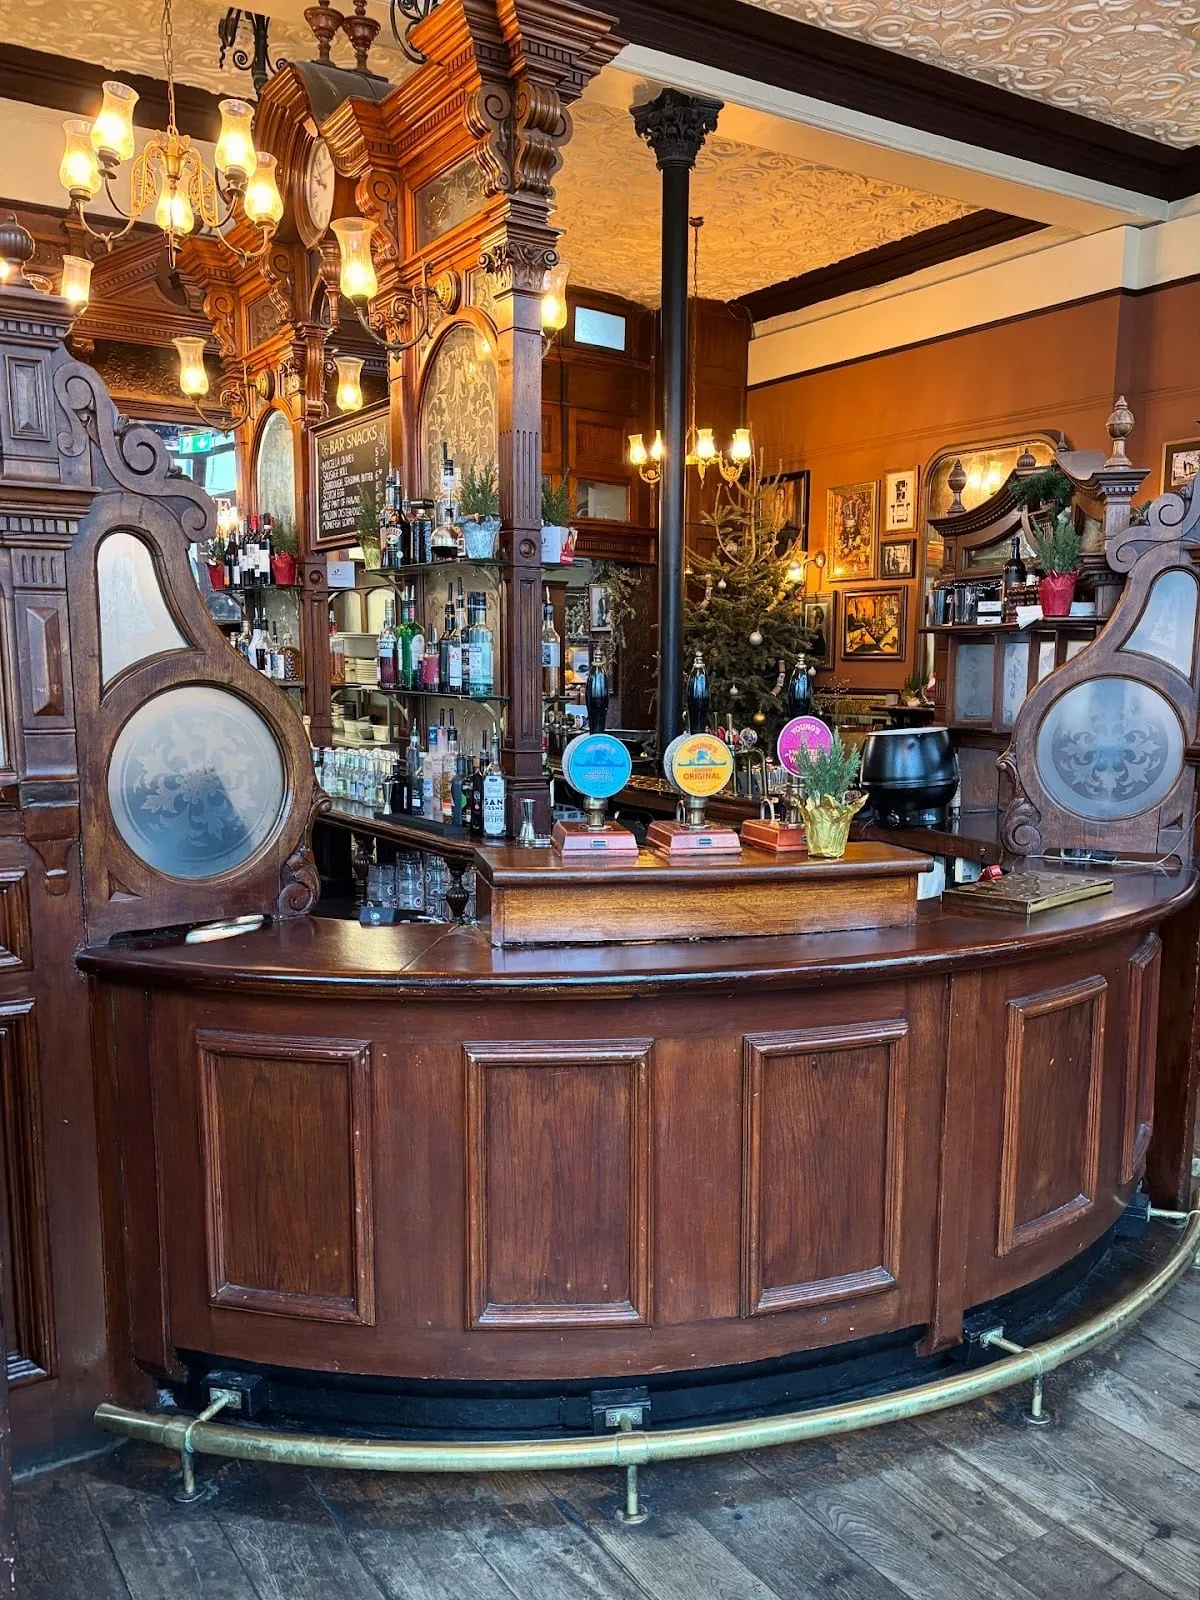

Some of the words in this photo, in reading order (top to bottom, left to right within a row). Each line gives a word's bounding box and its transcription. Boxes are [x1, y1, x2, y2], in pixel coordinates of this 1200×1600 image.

[329, 436, 345, 455] BAR
[346, 424, 378, 449] SNACKS
[340, 453, 355, 466] OLIVES
[791, 723, 822, 735] YOUNG'S
[687, 742, 718, 754] YOUNG'S
[683, 772, 721, 781] ORIGINAL
[484, 798, 503, 806] SAN
